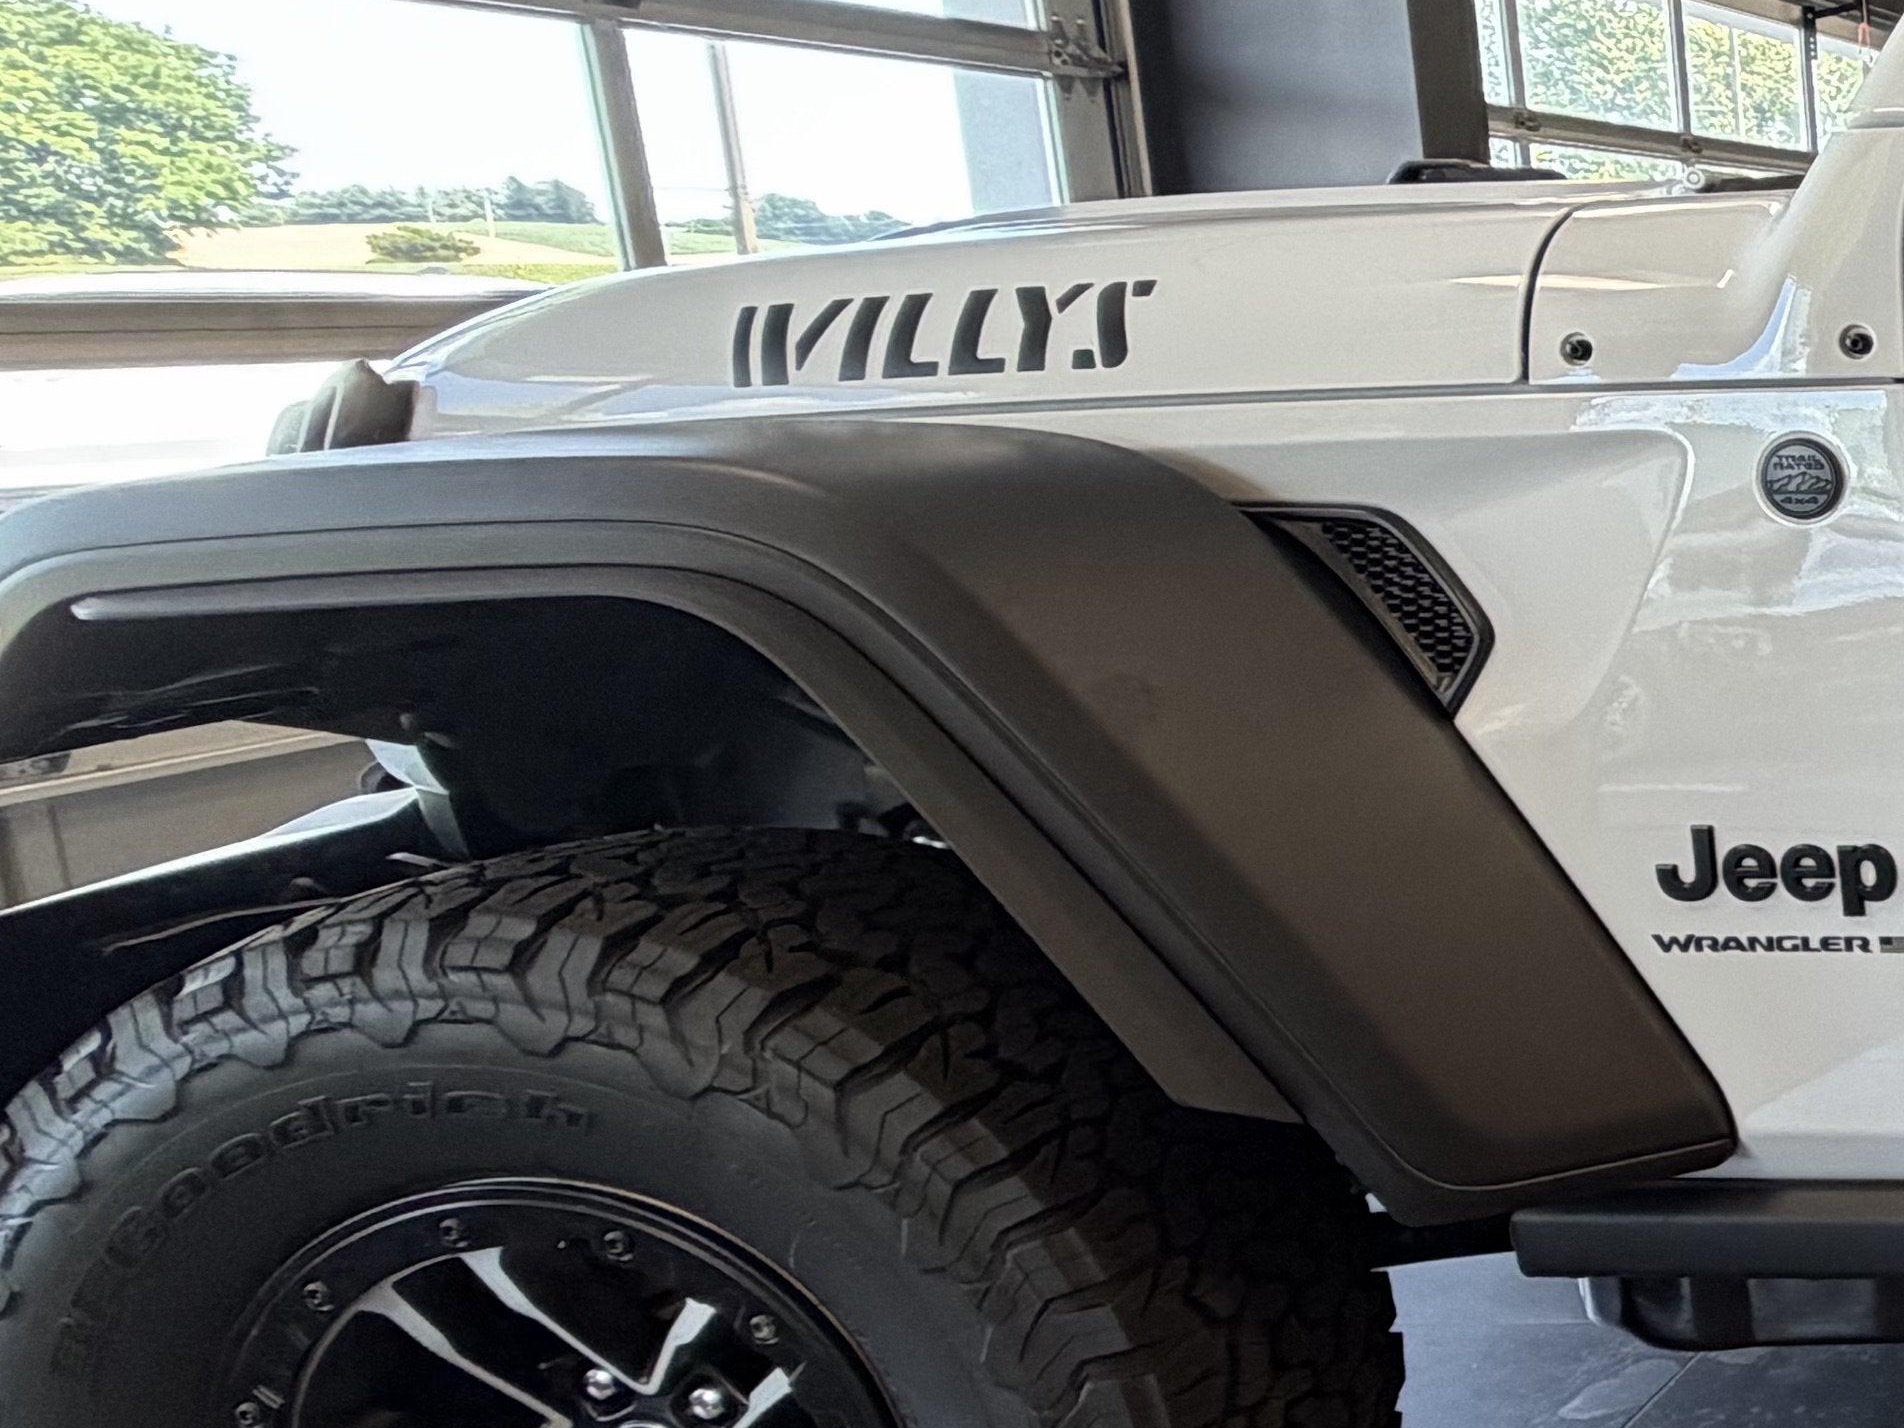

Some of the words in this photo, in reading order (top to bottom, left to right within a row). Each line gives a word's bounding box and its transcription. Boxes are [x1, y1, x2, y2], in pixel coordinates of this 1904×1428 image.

[732, 279, 1157, 388] WILLYS
[1655, 824, 1898, 916] Jeep
[1651, 934, 1873, 953] WRANGLER
